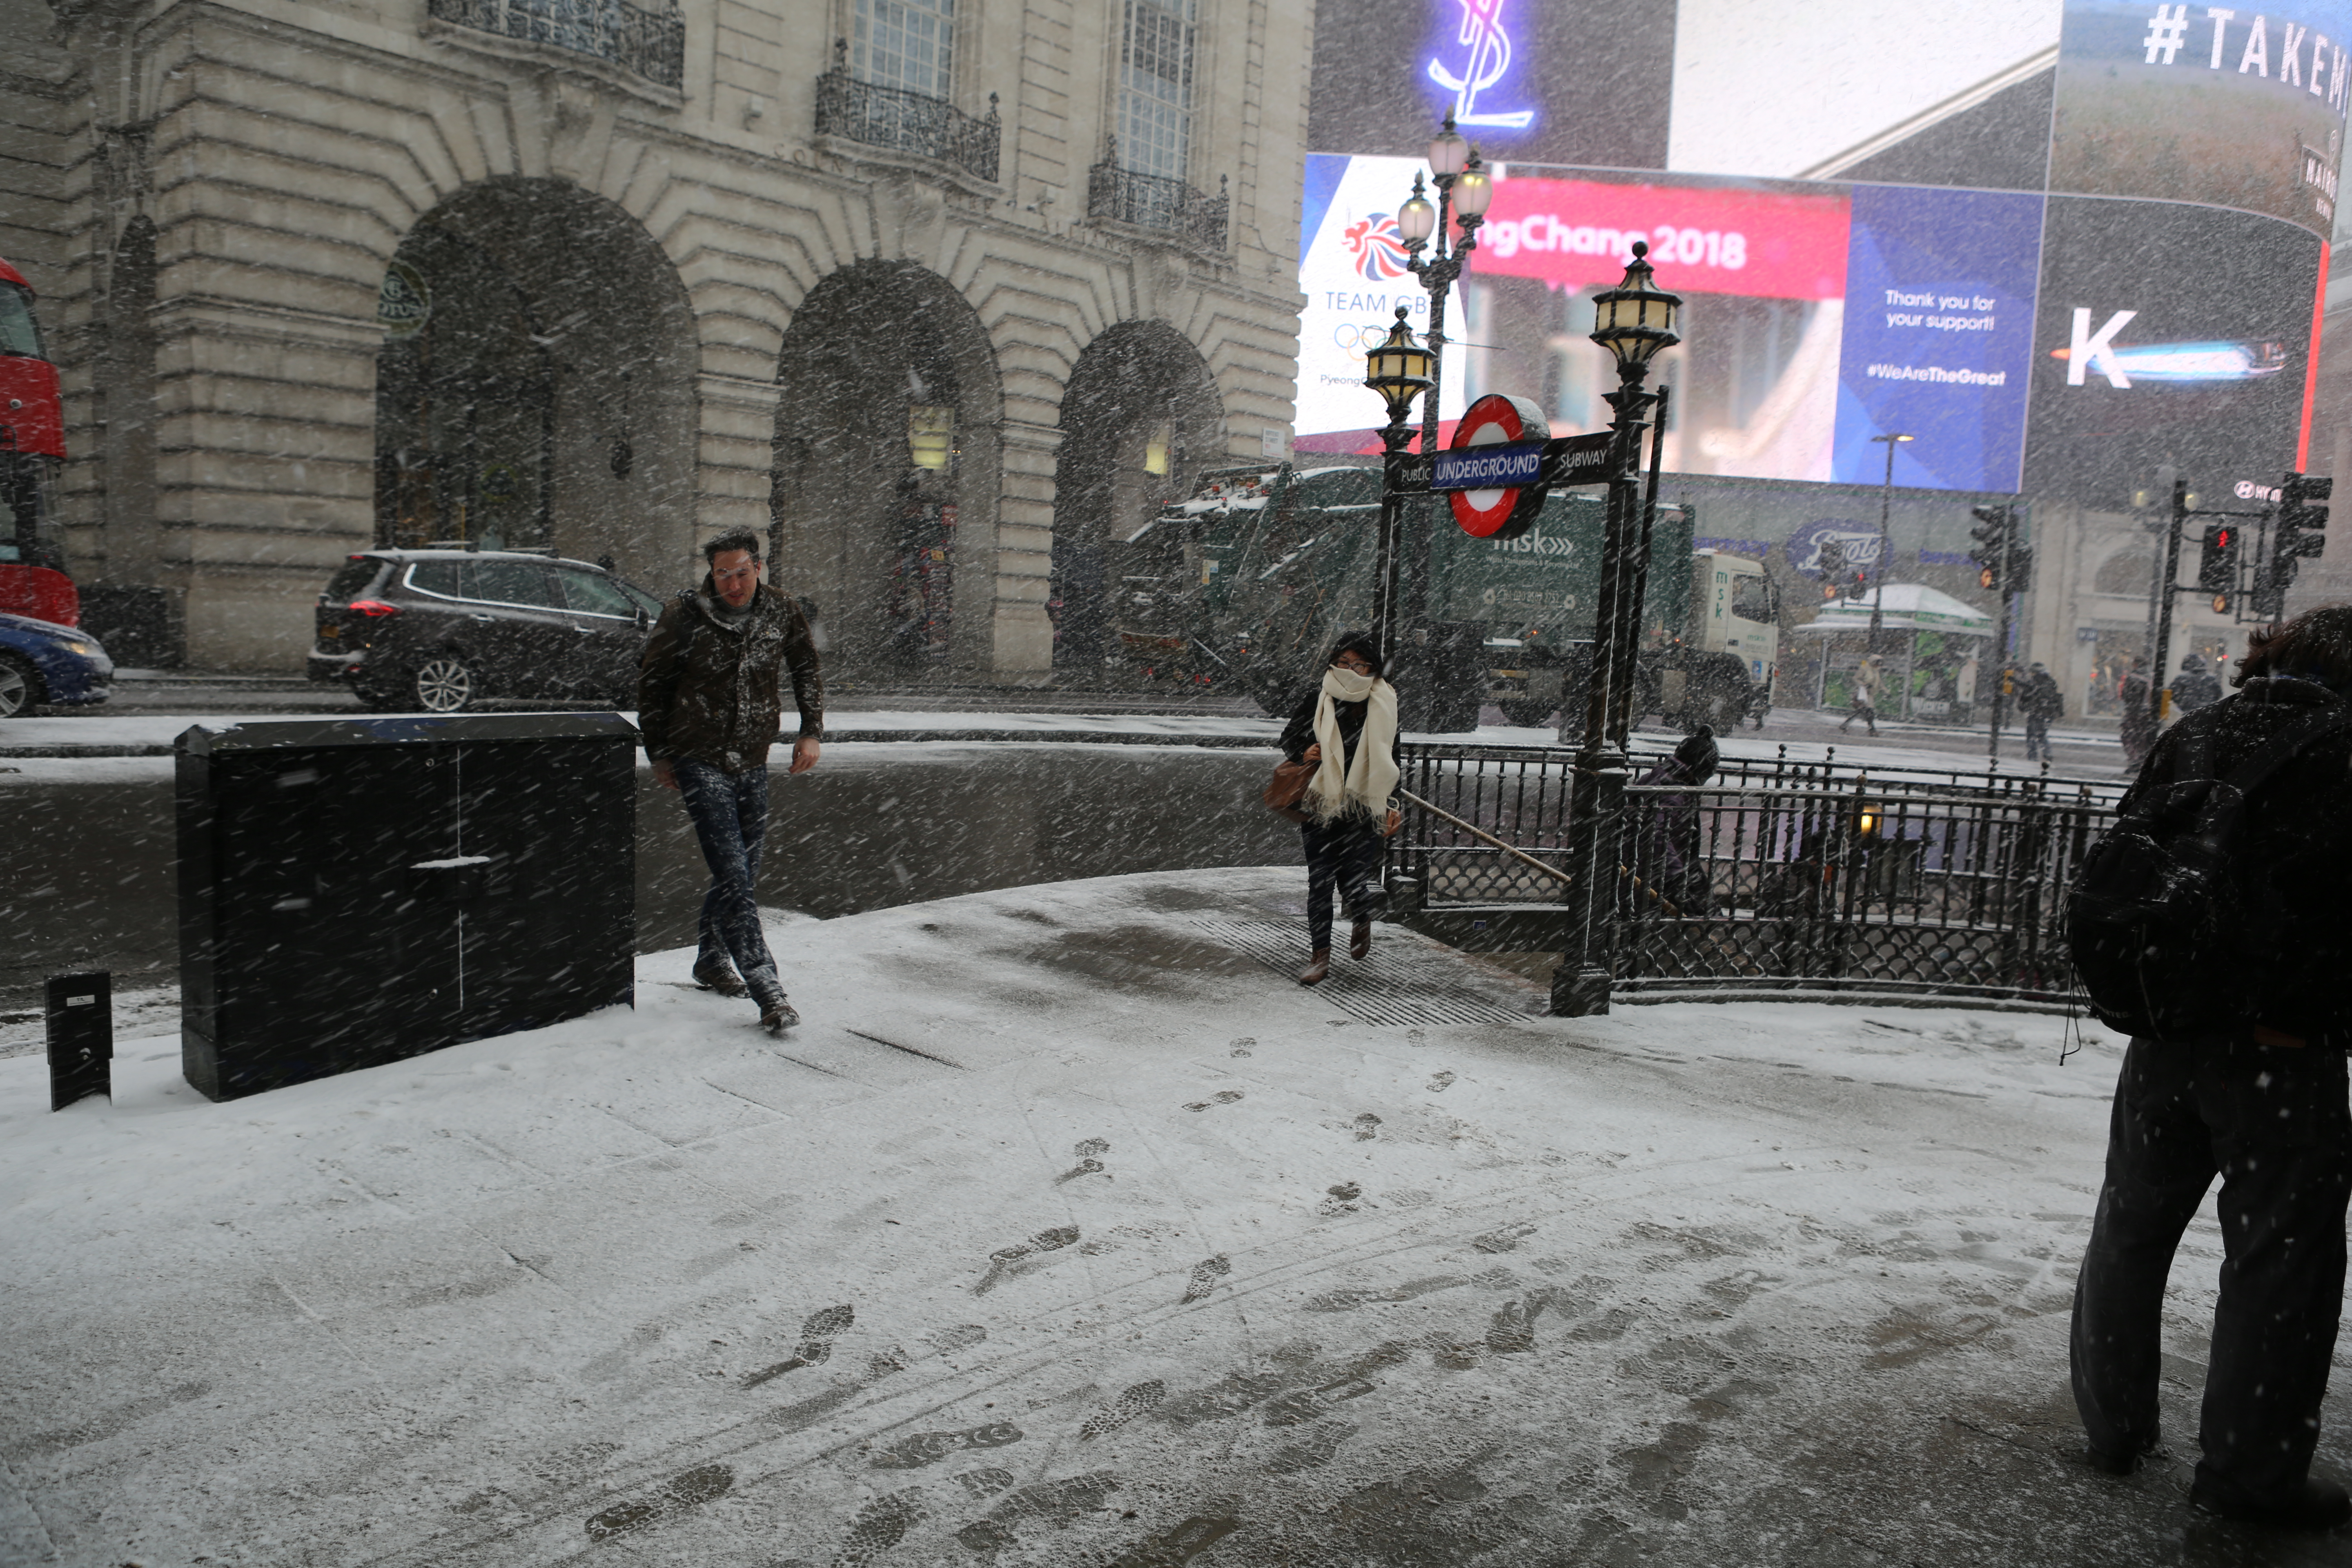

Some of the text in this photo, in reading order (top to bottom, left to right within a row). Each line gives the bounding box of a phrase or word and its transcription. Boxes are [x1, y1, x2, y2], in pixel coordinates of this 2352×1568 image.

[1651, 225, 1749, 270] 2018
[1325, 291, 1427, 314] TEAM GB
[1885, 289, 1996, 312] Thank you for
[1886, 312, 1995, 332] your support!
[2067, 307, 2138, 390] K
[1866, 363, 2007, 387] #WeAreTheGreat
[1401, 449, 1607, 482] PUBLIC UNDERGROUND SUBWAY
[1486, 555, 1503, 564] Waste
[1504, 557, 1538, 567] Management
[1545, 560, 1569, 570] Recycling
